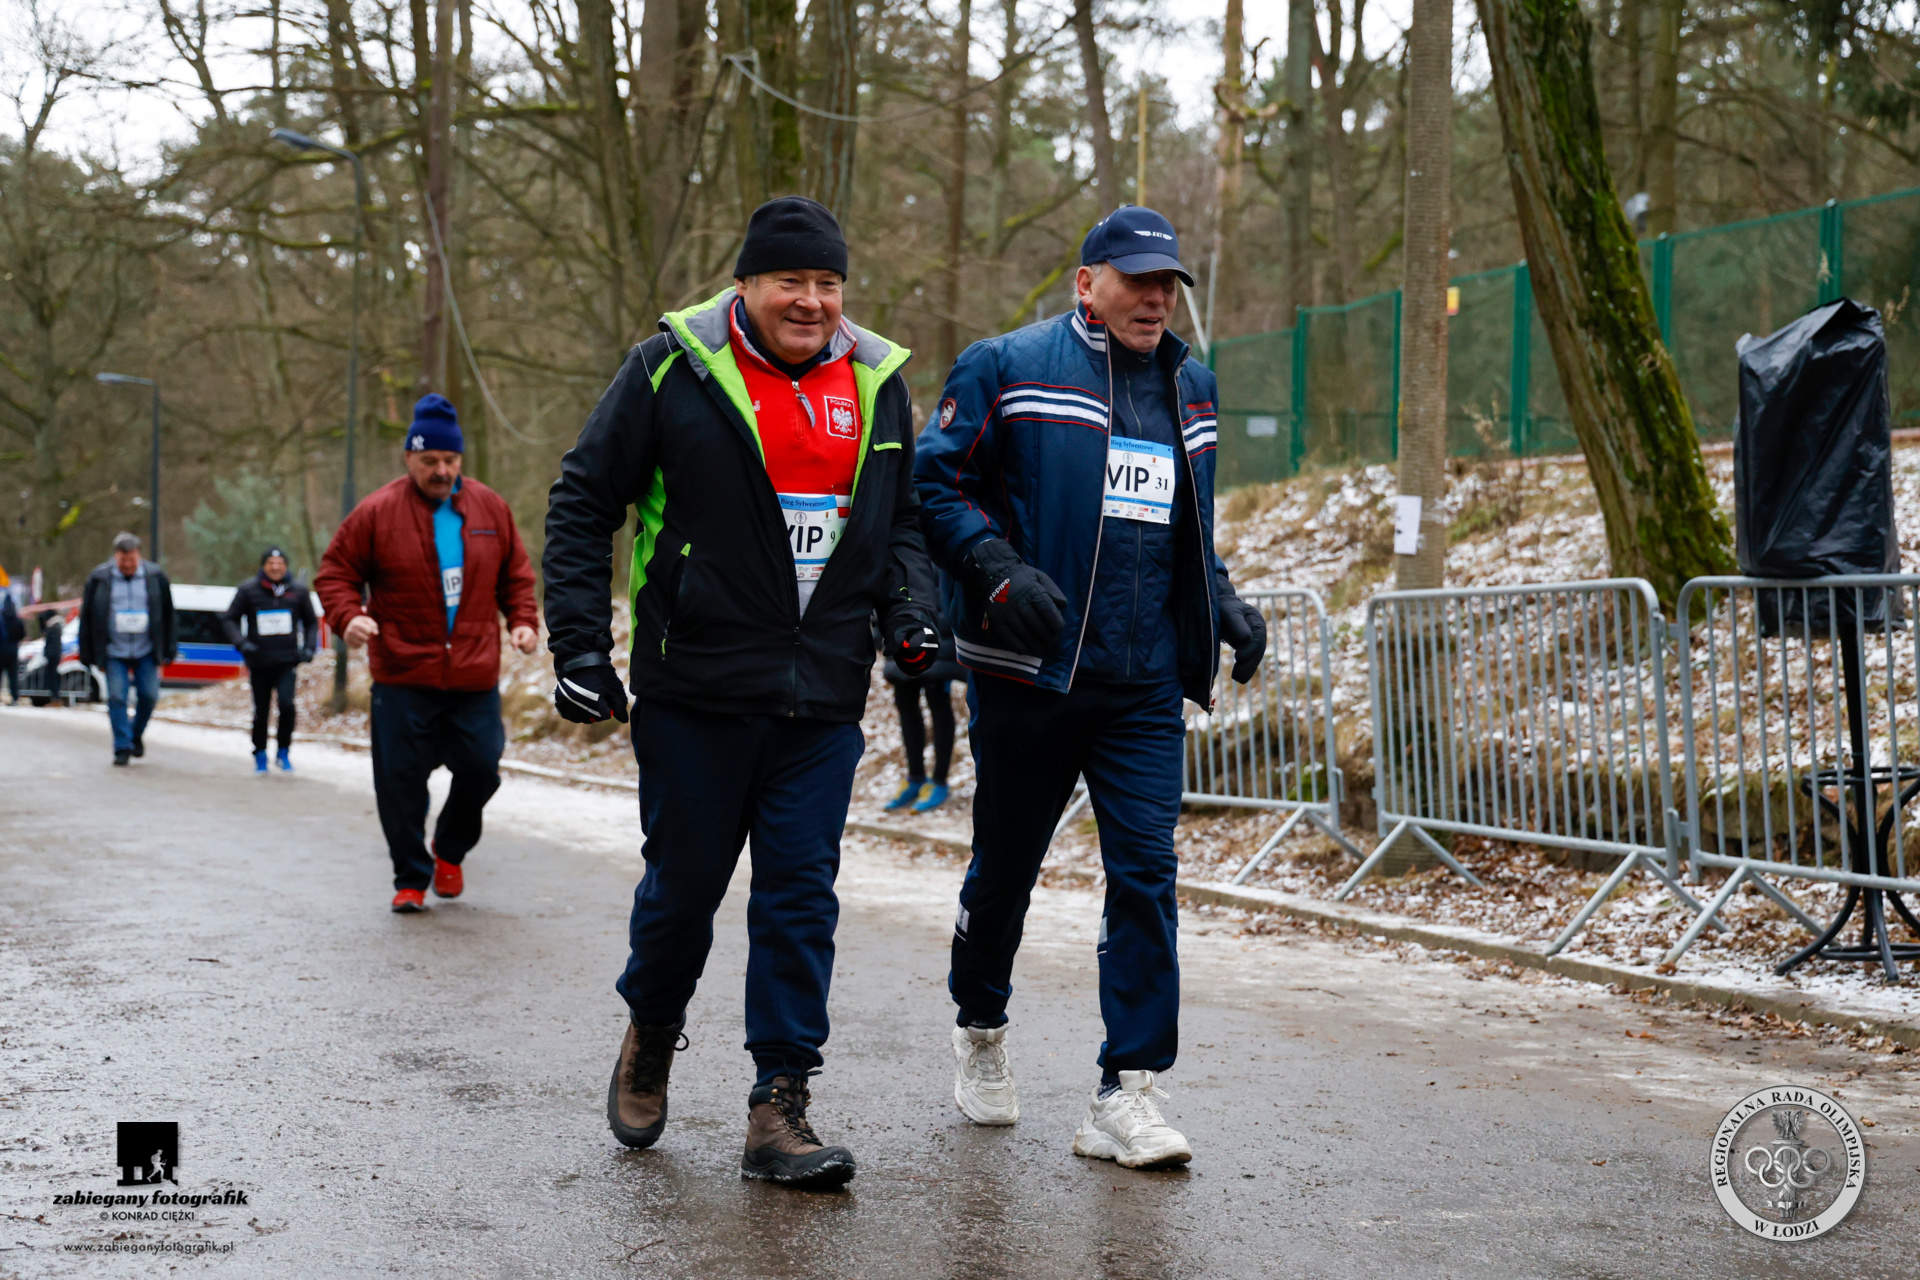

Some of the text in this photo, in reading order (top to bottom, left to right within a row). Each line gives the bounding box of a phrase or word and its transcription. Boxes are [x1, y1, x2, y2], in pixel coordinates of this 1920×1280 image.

[1108, 464, 1168, 492] VIP 31
[830, 530, 836, 544] 9
